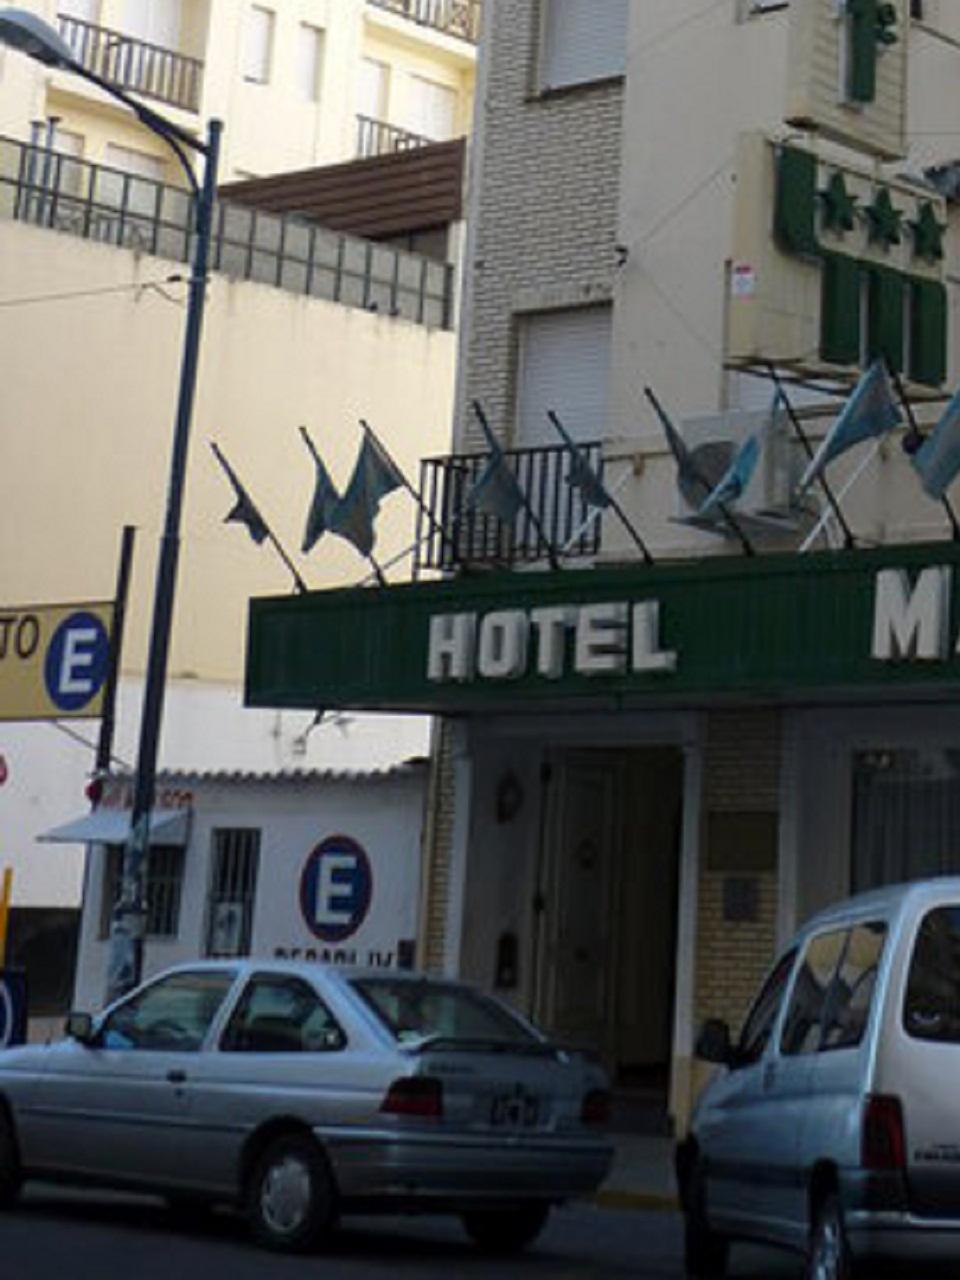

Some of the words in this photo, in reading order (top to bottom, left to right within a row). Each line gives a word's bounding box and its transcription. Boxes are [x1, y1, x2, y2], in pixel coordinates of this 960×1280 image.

[59, 627, 97, 694] E
[427, 598, 678, 684] HOTEL
[314, 855, 357, 924] E
